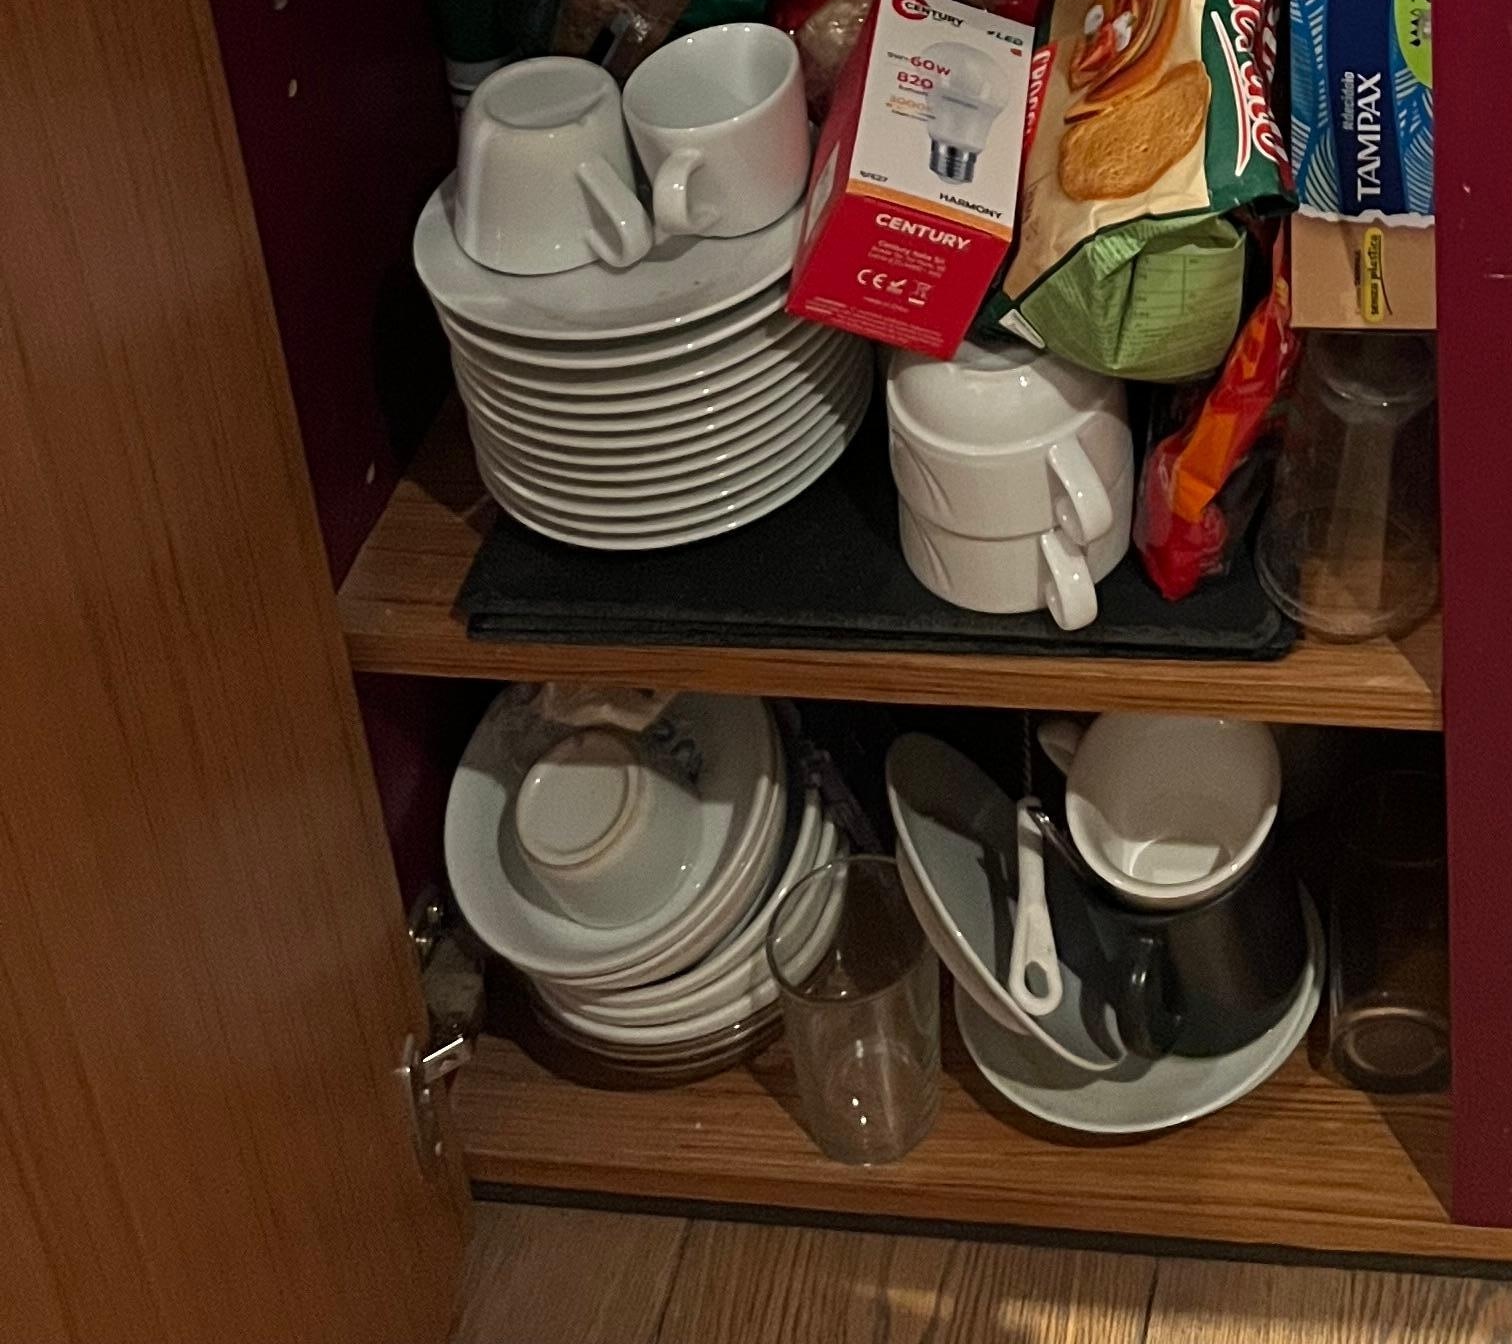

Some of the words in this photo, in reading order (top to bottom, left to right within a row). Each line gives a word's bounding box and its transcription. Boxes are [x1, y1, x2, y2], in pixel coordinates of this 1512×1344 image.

[904, 0, 965, 28] CENTURY
[995, 32, 1024, 47] LED
[1357, 71, 1381, 202] TAMPAX
[939, 192, 1003, 220] HARMONY
[875, 213, 972, 250] CENTURY
